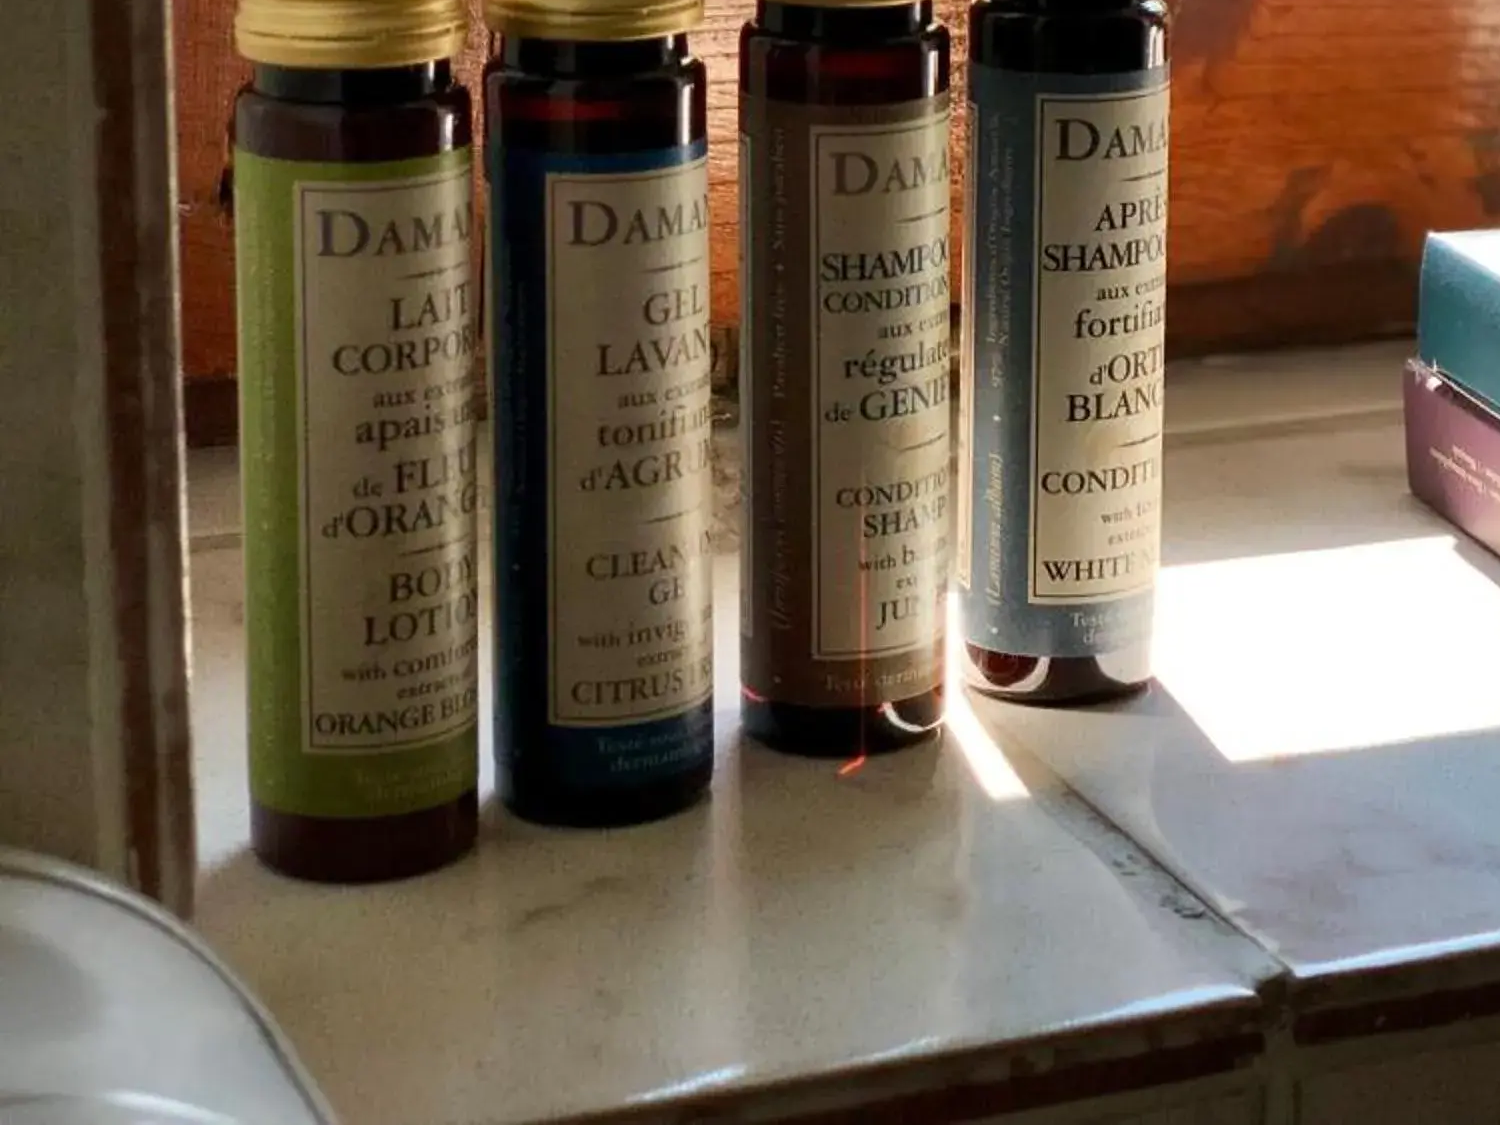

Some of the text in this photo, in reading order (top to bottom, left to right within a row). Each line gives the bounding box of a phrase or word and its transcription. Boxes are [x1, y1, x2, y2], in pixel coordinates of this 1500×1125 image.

[1054, 115, 1166, 162] DAMA
[821, 235, 947, 282] SHAMPO
[642, 285, 703, 326] GEL
[332, 316, 476, 376] CORPOR
[596, 323, 707, 377] LAVAN
[824, 399, 855, 423] de
[863, 495, 947, 539] SHAMP
[571, 669, 684, 706] CITRUS
[315, 703, 436, 737] ORANGE
